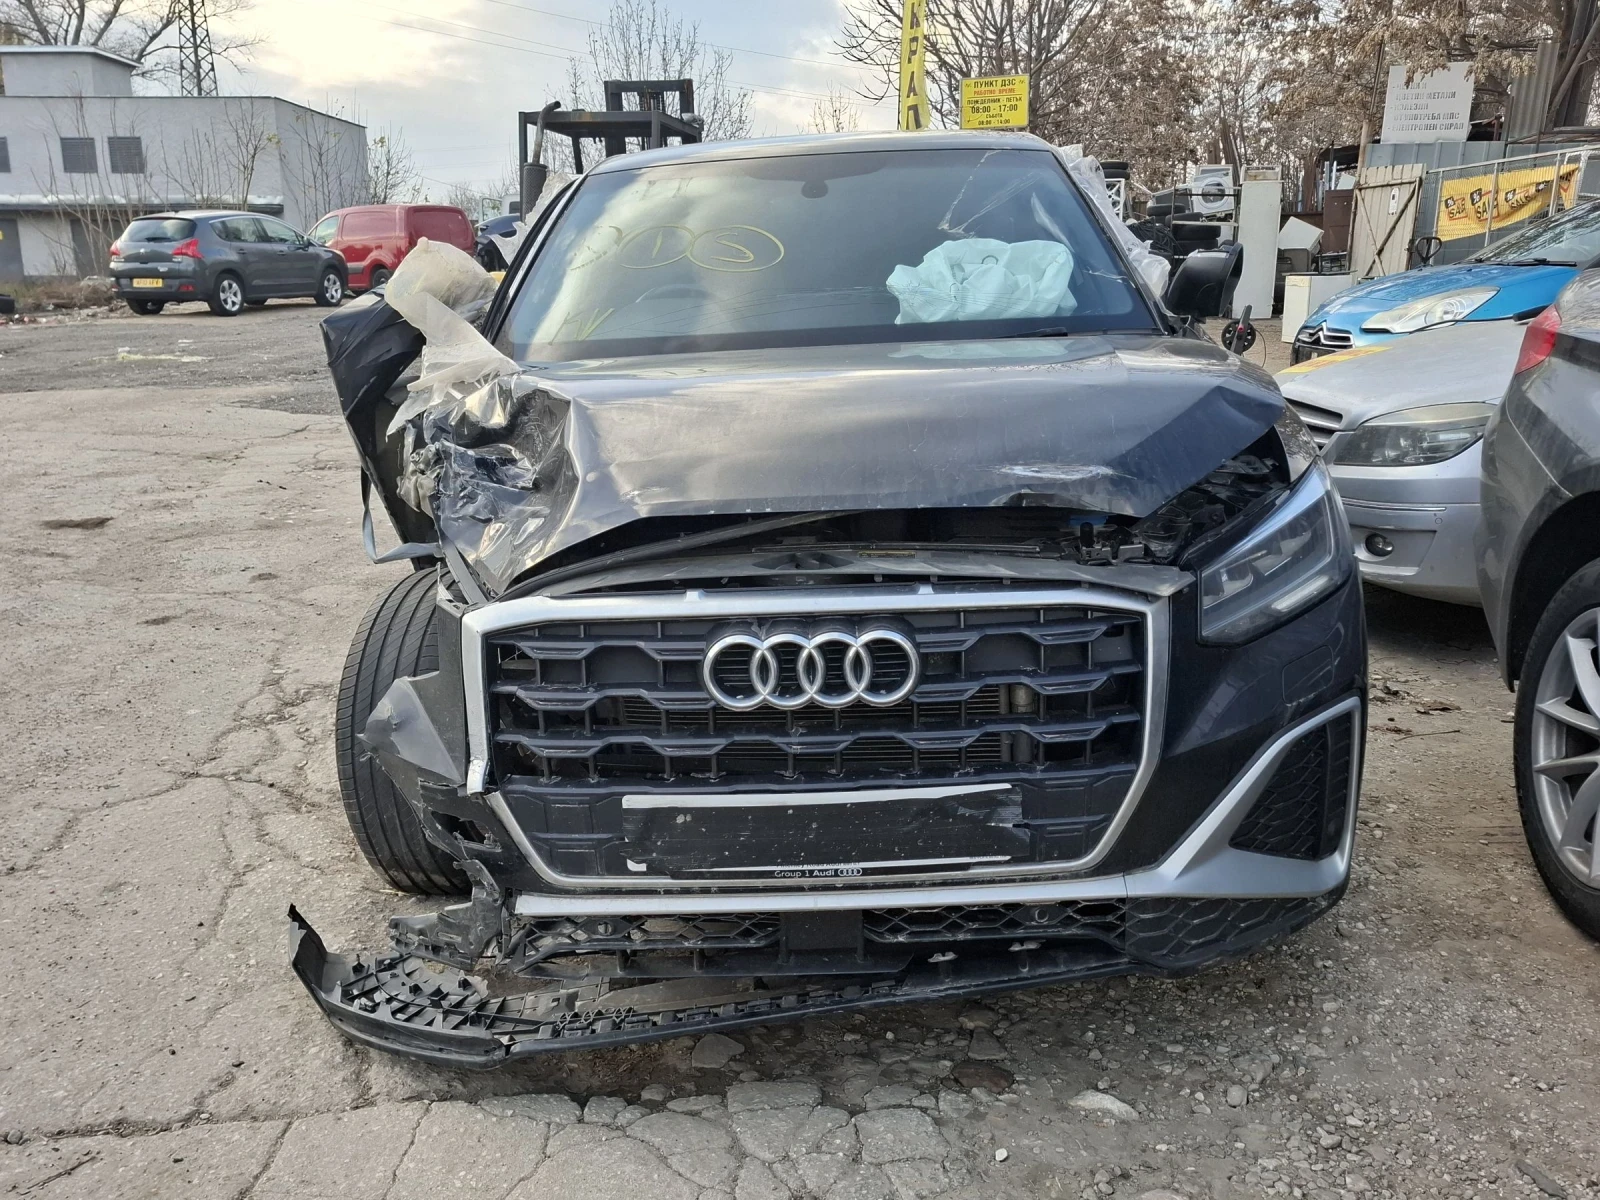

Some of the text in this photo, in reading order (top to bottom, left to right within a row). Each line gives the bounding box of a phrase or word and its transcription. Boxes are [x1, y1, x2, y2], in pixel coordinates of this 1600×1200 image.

[973, 78, 1016, 89] ПУНКТ ДЗС
[1396, 82, 1420, 90] ЧЕНИ
[1425, 91, 1456, 100] МЕТАЛИ
[966, 98, 1001, 106] ПОНЕДЕЛНИК
[971, 105, 991, 114] 08:00
[998, 103, 1018, 112] 17:00
[1404, 112, 1441, 121] УПОТРЕБА
[1442, 111, 1460, 120] МПС
[774, 870, 802, 878] Group
[812, 869, 835, 877] Audi
